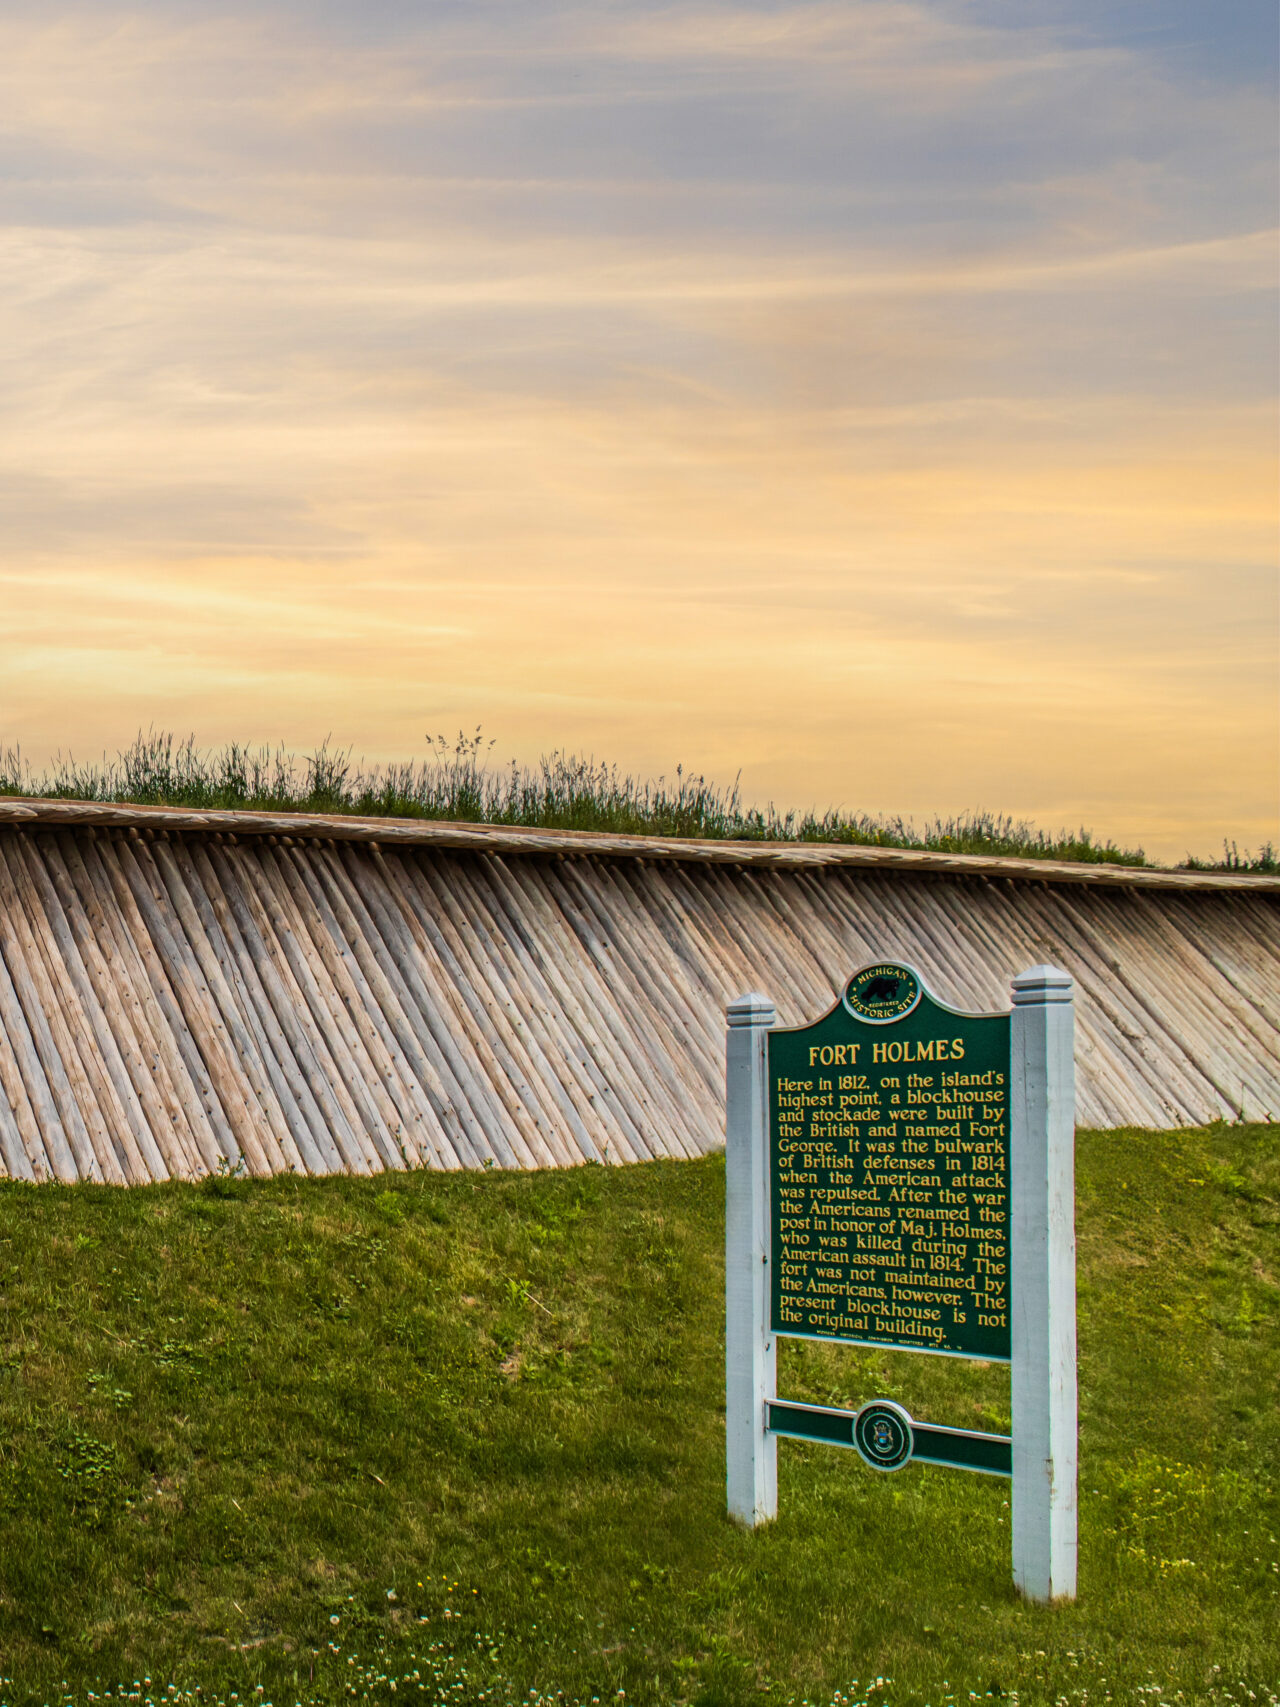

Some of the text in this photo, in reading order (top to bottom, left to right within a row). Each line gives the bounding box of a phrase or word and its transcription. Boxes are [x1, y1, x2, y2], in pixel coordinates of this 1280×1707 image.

[857, 967, 908, 984] MICHIGAN
[850, 991, 916, 1018] HISTORIC SITE
[810, 1038, 965, 1066] FORT HOLMES
[778, 1078, 813, 1091] Here
[819, 1077, 832, 1090] in
[880, 1078, 900, 1088] on
[907, 1074, 933, 1087] the
[941, 1071, 1004, 1087] island's
[779, 1093, 833, 1109] highest
[891, 1094, 900, 1104] a
[908, 1089, 1004, 1104] blockhouse
[779, 1105, 1005, 1122] and stockade were built by
[779, 1122, 1005, 1137] the British and named Fort
[779, 1139, 1005, 1156] George. It was the bulwark
[779, 1154, 1005, 1171] of British defenses in 1814
[779, 1170, 1006, 1188] when the American attack
[780, 1187, 1006, 1205] was repulsed. After the war
[780, 1200, 1005, 1222] the Americans renamed the
[780, 1218, 810, 1232] post
[814, 1217, 827, 1230] in
[831, 1218, 876, 1233] honor
[879, 1220, 896, 1234] of
[901, 1220, 937, 1239] Maj.
[780, 1231, 1005, 1259] who was killed during the
[781, 1246, 1006, 1275] American assault in 1814. The
[781, 1261, 1005, 1295] fort was not maintained by
[780, 1277, 803, 1291] the
[893, 1286, 962, 1306] however.
[971, 1292, 1006, 1309] The
[780, 1296, 1006, 1327] present blockhouse is not
[779, 1308, 803, 1323] the
[809, 1312, 868, 1331] original
[876, 1317, 947, 1342] building.
